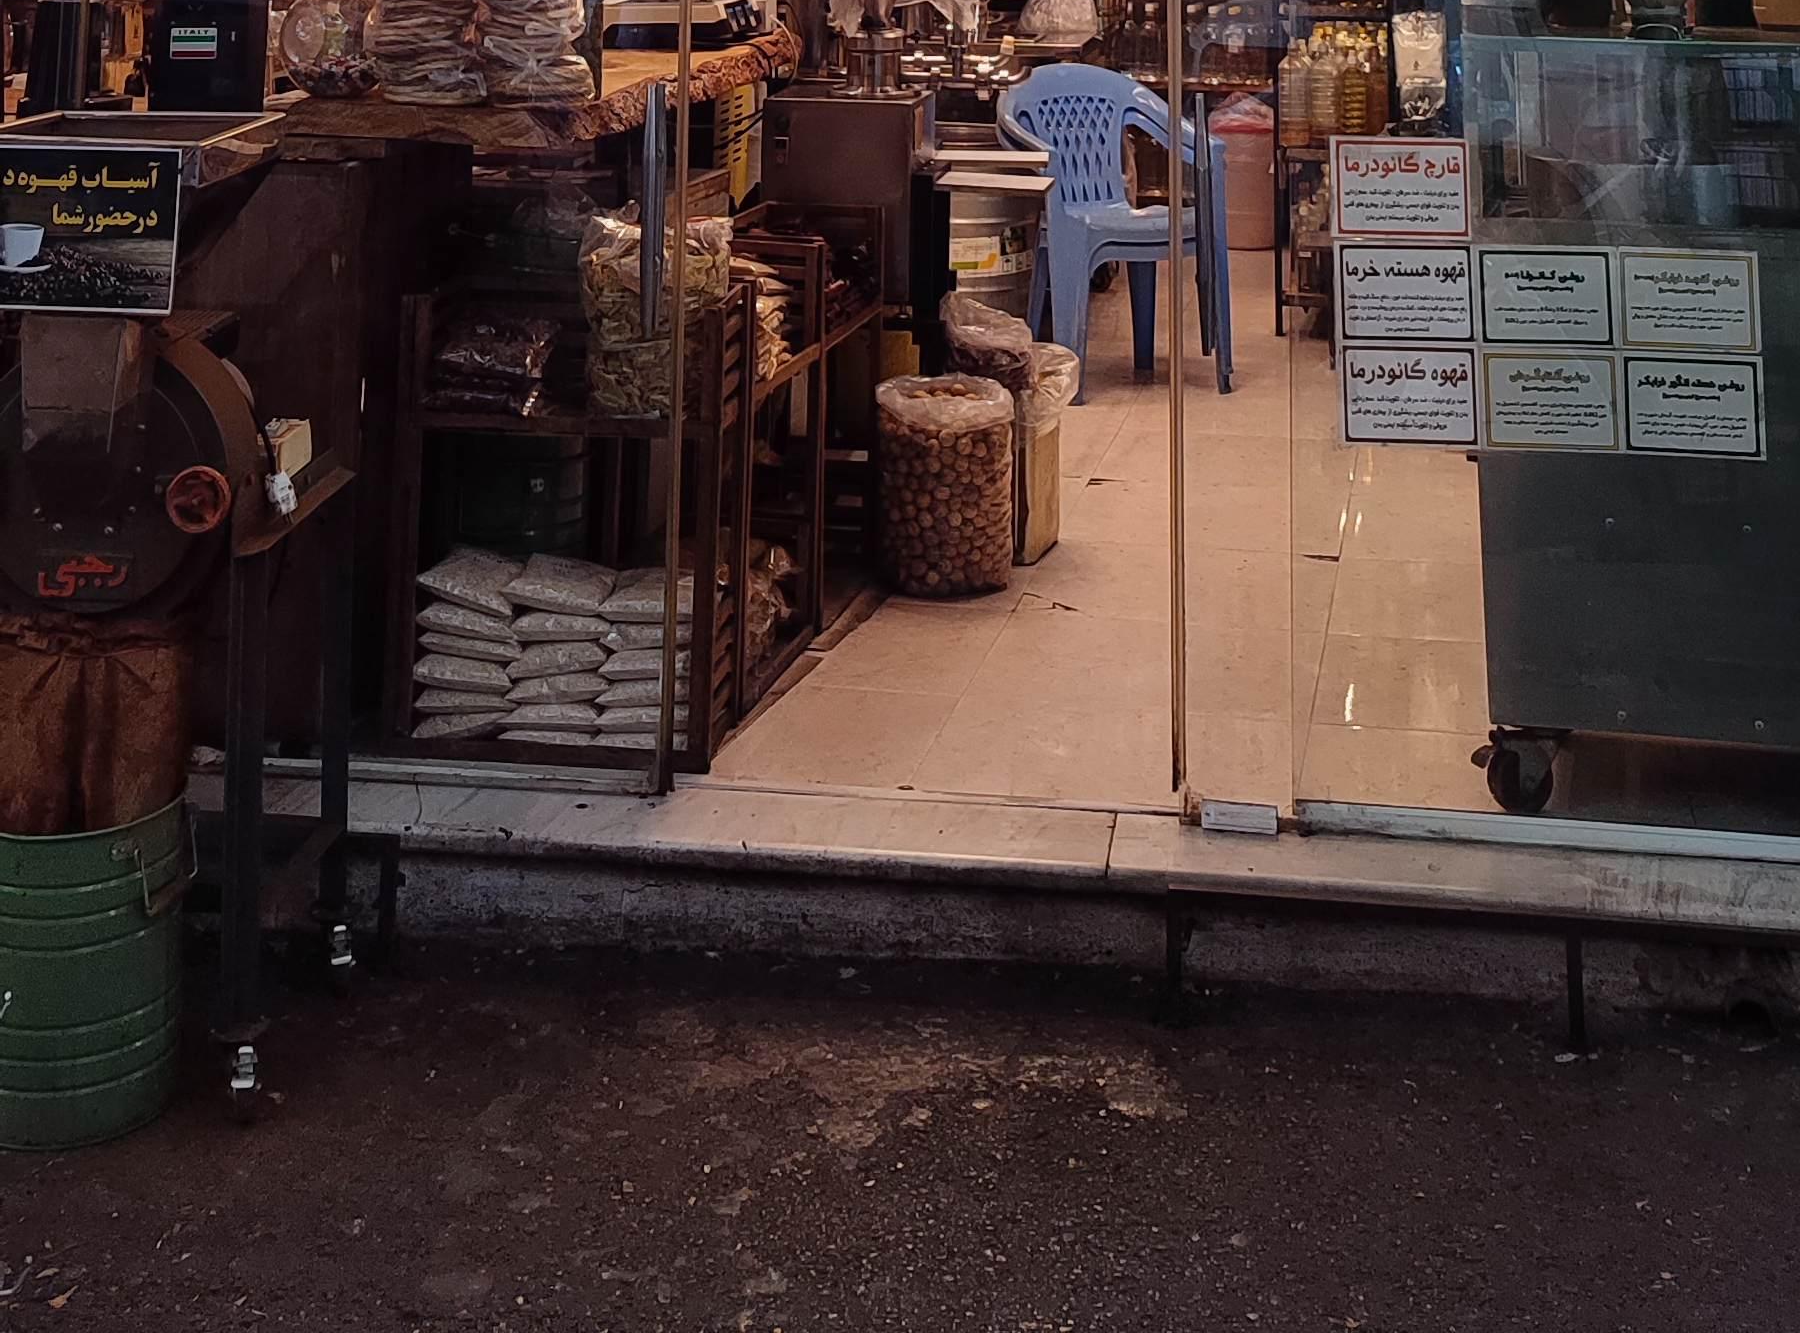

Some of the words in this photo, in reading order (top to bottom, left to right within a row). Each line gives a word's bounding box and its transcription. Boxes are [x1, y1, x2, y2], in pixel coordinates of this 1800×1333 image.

[3, 168, 15, 186] د
[1344, 151, 1420, 179] گانودرما
[1423, 157, 1461, 179] قارچ
[17, 165, 78, 194] قهوه
[81, 162, 161, 193] آسیاب
[1345, 259, 1381, 283] خرما
[1384, 260, 1431, 277] هسته
[1434, 261, 1466, 284] قهوه
[1350, 358, 1427, 386] گانودرما
[1430, 363, 1468, 388] قهوه
